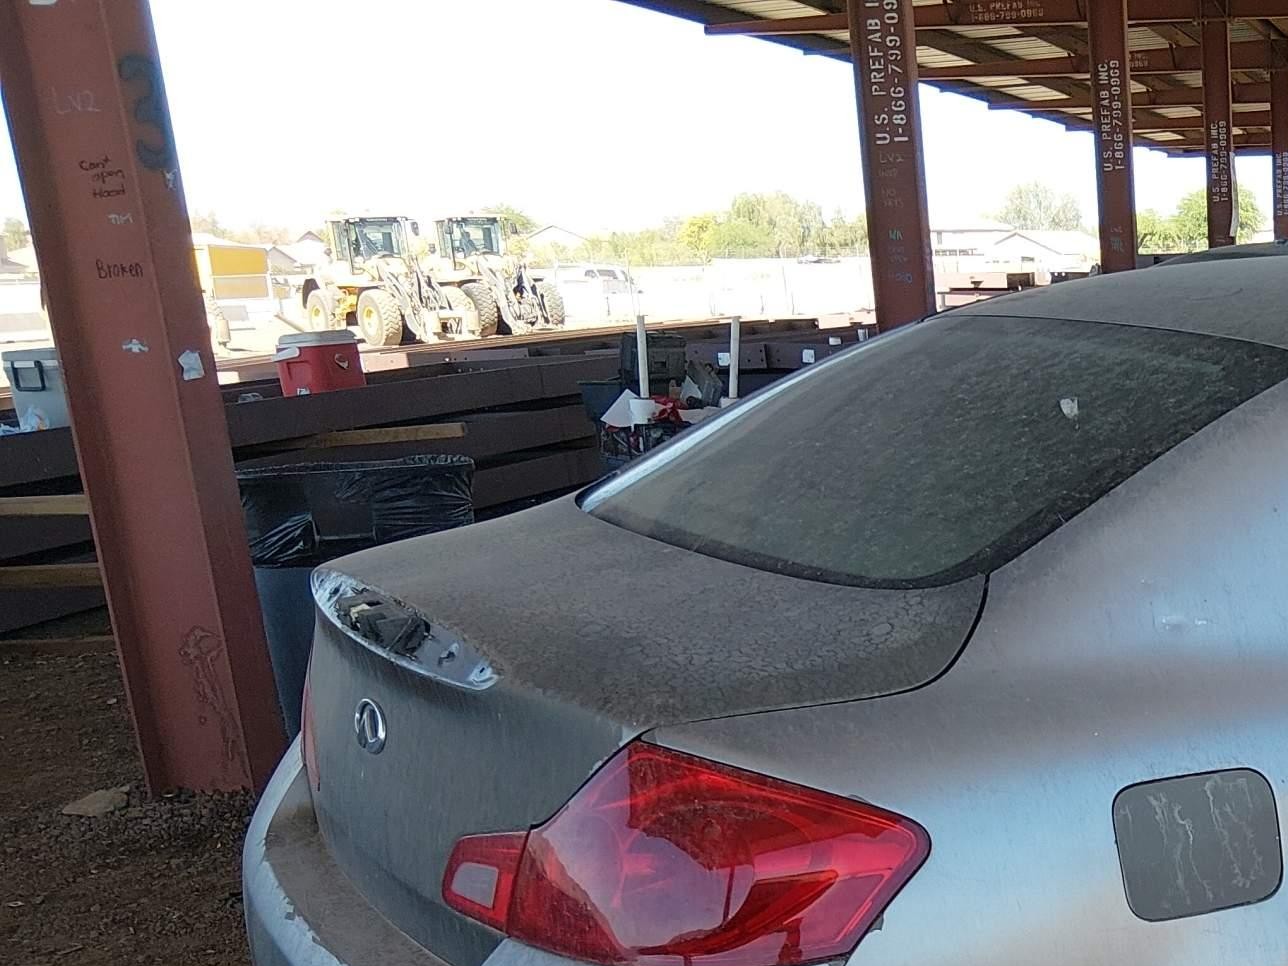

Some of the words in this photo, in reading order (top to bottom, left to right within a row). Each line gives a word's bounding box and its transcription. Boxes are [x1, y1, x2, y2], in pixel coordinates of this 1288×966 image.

[866, 18, 887, 95] PREFAB
[1098, 59, 1109, 84] INC.
[874, 107, 891, 145] U.S.
[1100, 90, 1112, 140] PREFAB
[1103, 147, 1114, 171] U.S.
